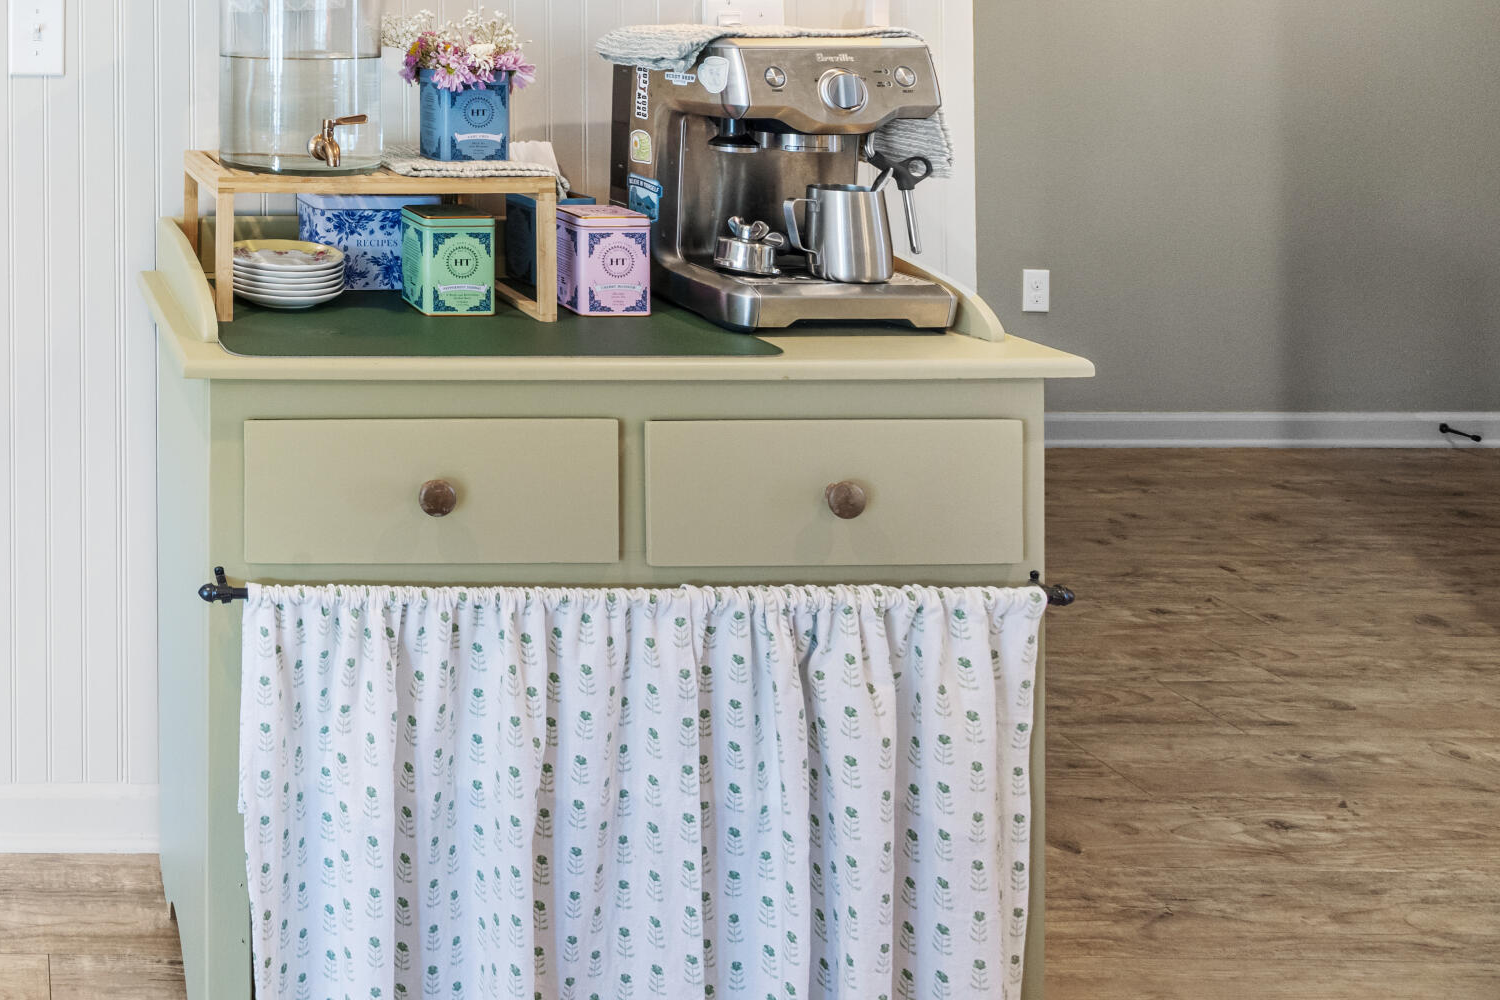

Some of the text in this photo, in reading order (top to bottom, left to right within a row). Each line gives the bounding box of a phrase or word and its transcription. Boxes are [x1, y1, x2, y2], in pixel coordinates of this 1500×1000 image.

[815, 53, 855, 63] Breville
[471, 108, 487, 117] HT
[356, 239, 398, 248] RECIPES
[454, 258, 471, 267] HT
[610, 257, 627, 266] HT
